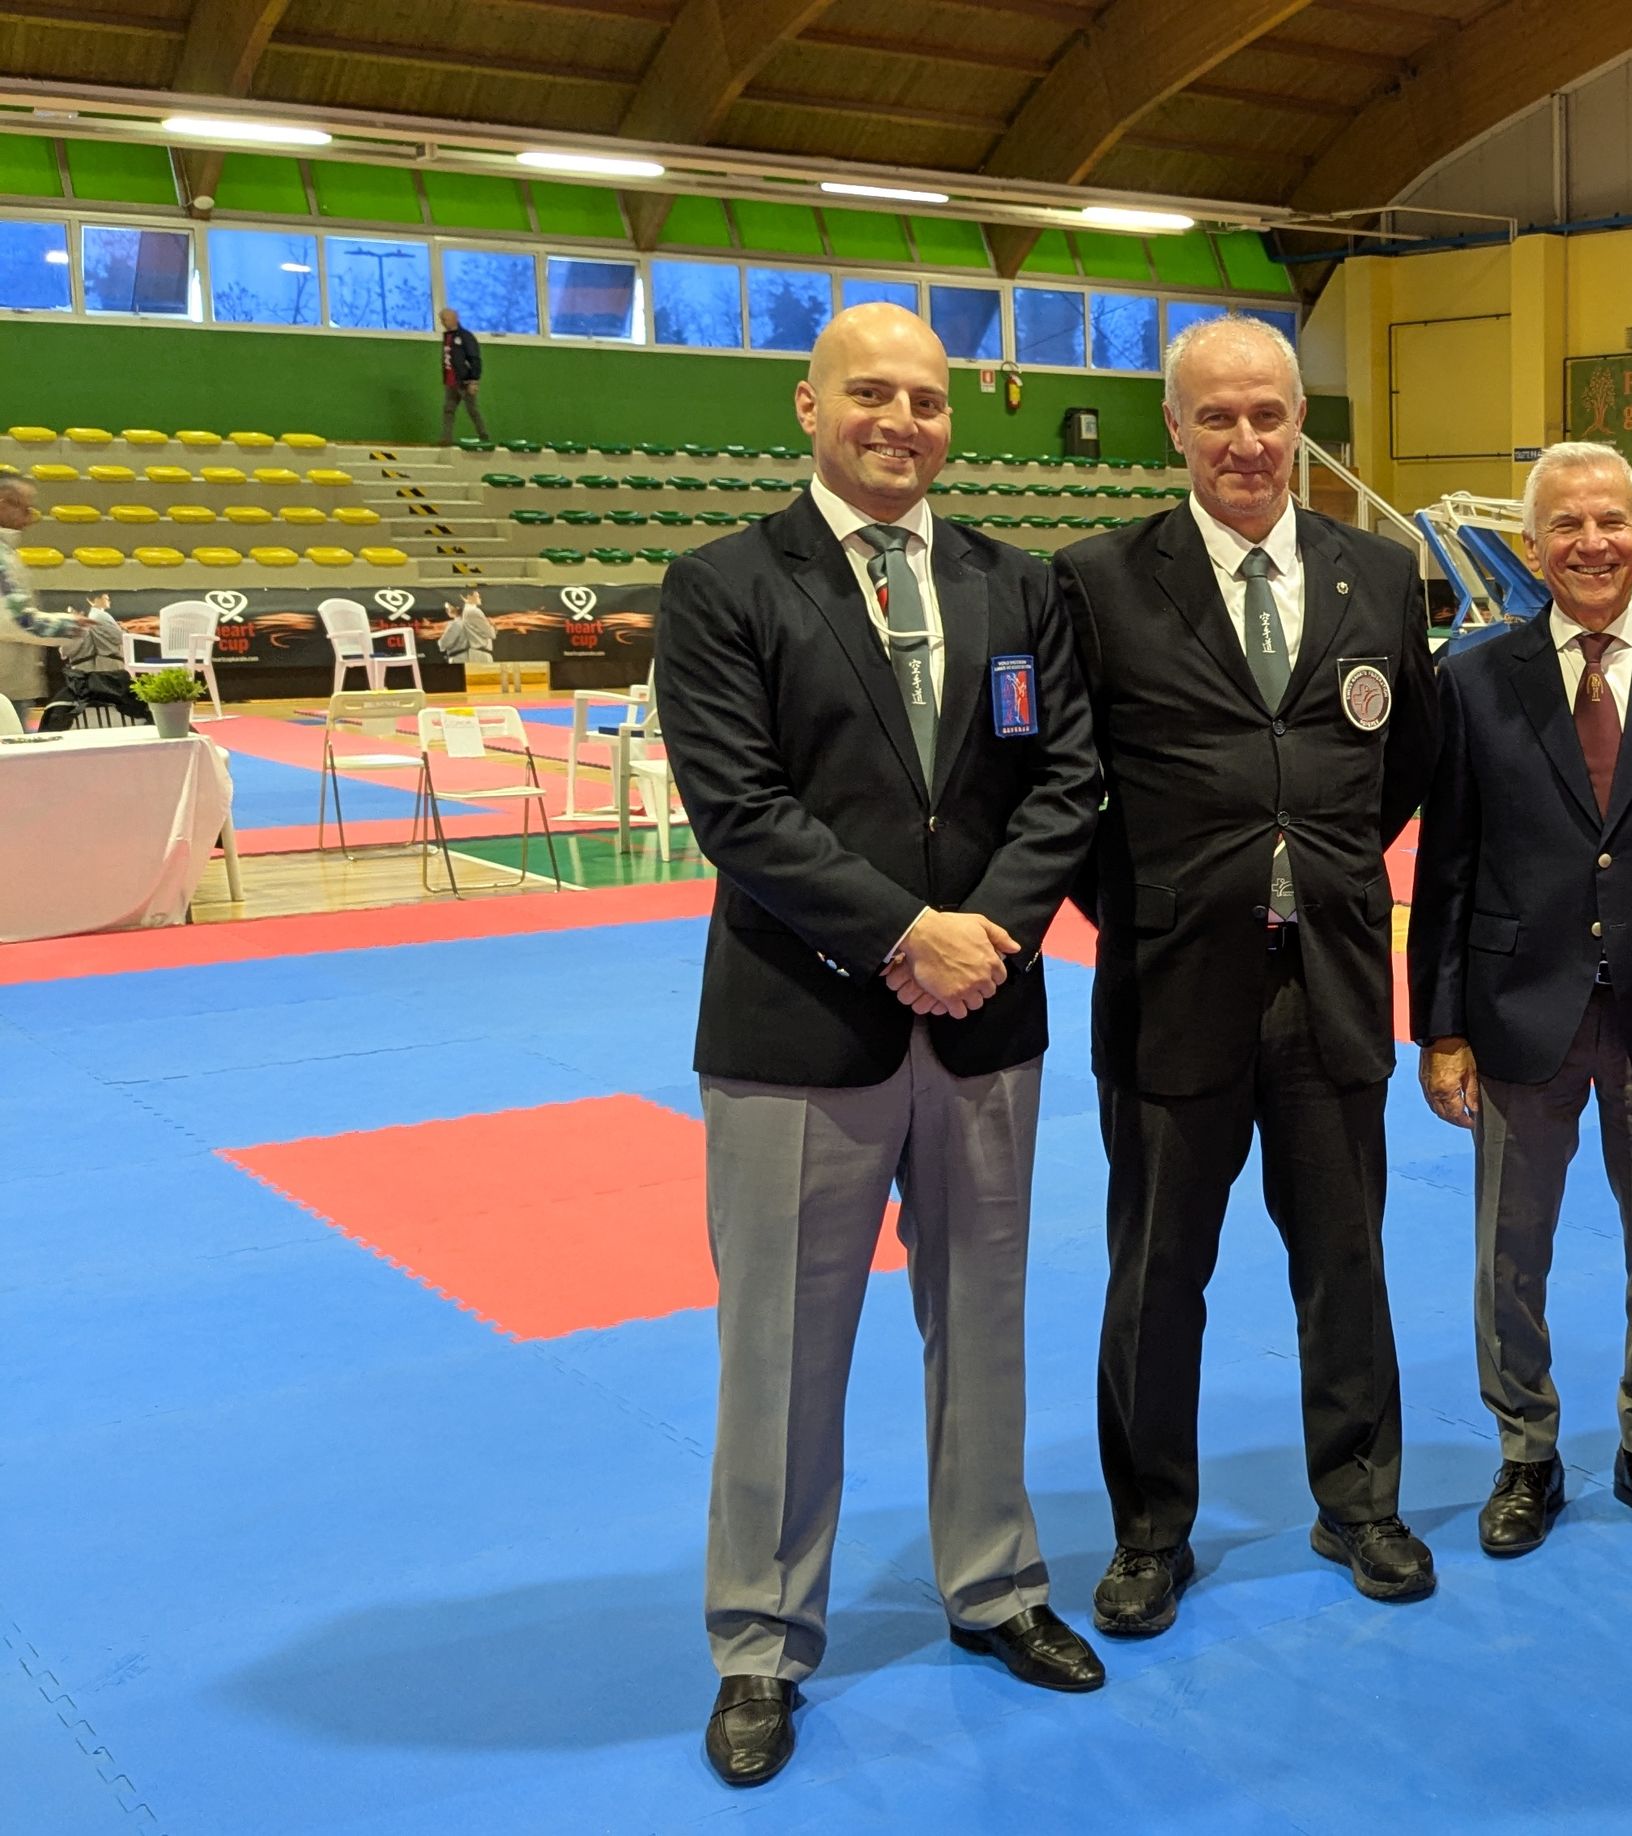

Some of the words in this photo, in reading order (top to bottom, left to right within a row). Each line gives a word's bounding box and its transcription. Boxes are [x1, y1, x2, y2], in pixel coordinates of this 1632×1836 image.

[564, 619, 604, 634] heart
[219, 638, 249, 654] cup
[571, 635, 598, 649] cup
